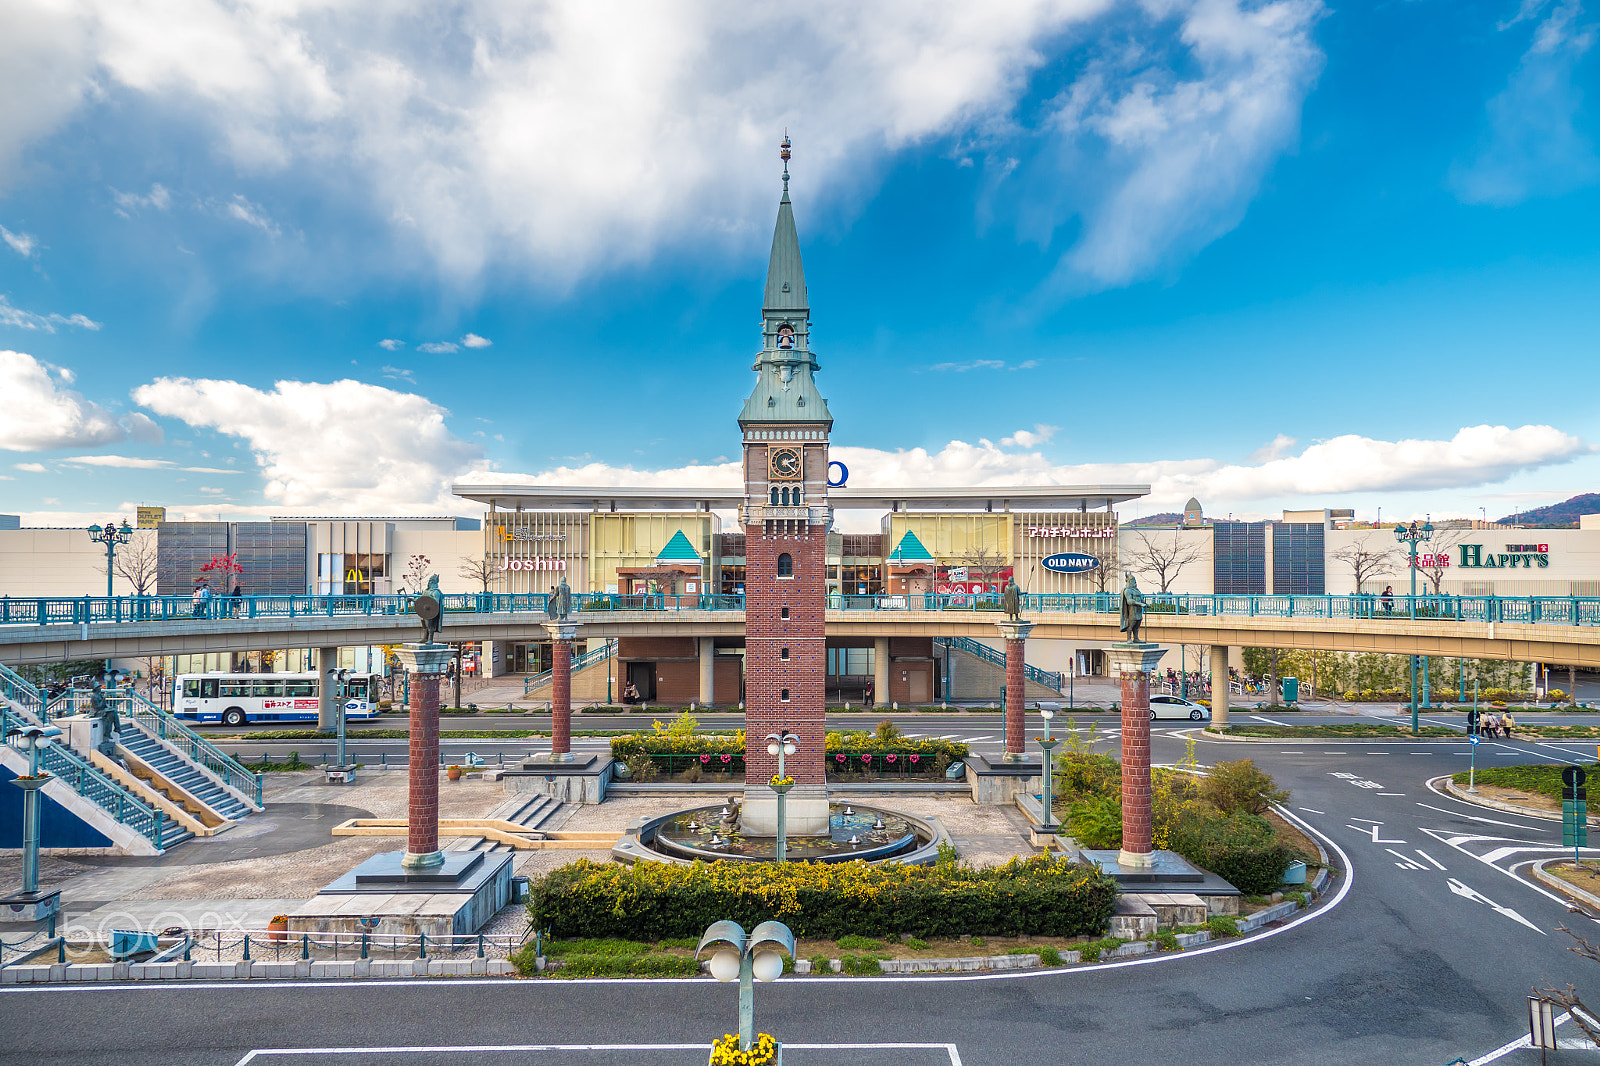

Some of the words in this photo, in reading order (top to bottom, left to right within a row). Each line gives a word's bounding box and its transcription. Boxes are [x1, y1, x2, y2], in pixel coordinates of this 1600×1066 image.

[497, 555, 567, 571] Joshin
[1048, 558, 1067, 567] OLD
[1068, 558, 1094, 567] NAVY
